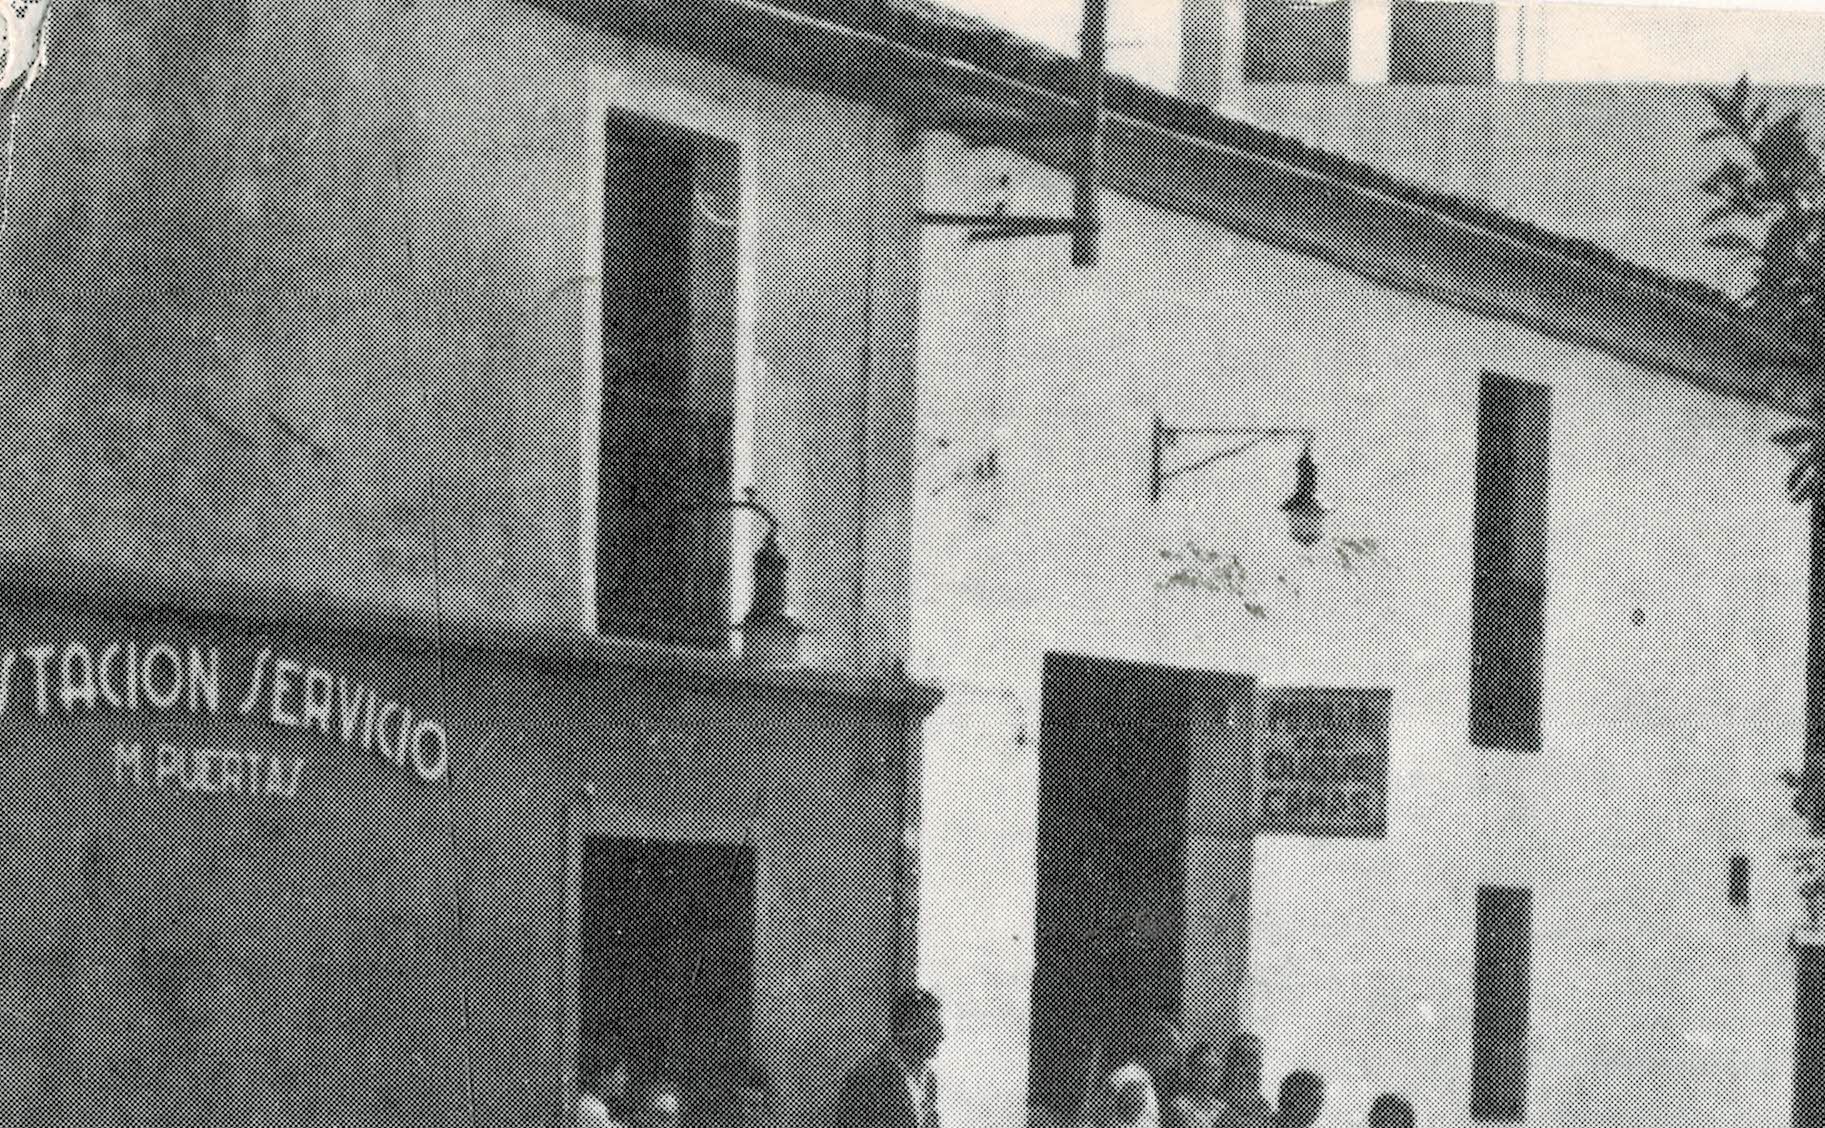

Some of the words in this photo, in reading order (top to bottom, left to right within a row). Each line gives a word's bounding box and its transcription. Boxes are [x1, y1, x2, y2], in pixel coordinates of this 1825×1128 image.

[238, 646, 449, 781] SERVICIO
[155, 743, 305, 799] PUERTAS
[1265, 751, 1373, 784] DUQUE
[1263, 787, 1371, 820] CAMAS
